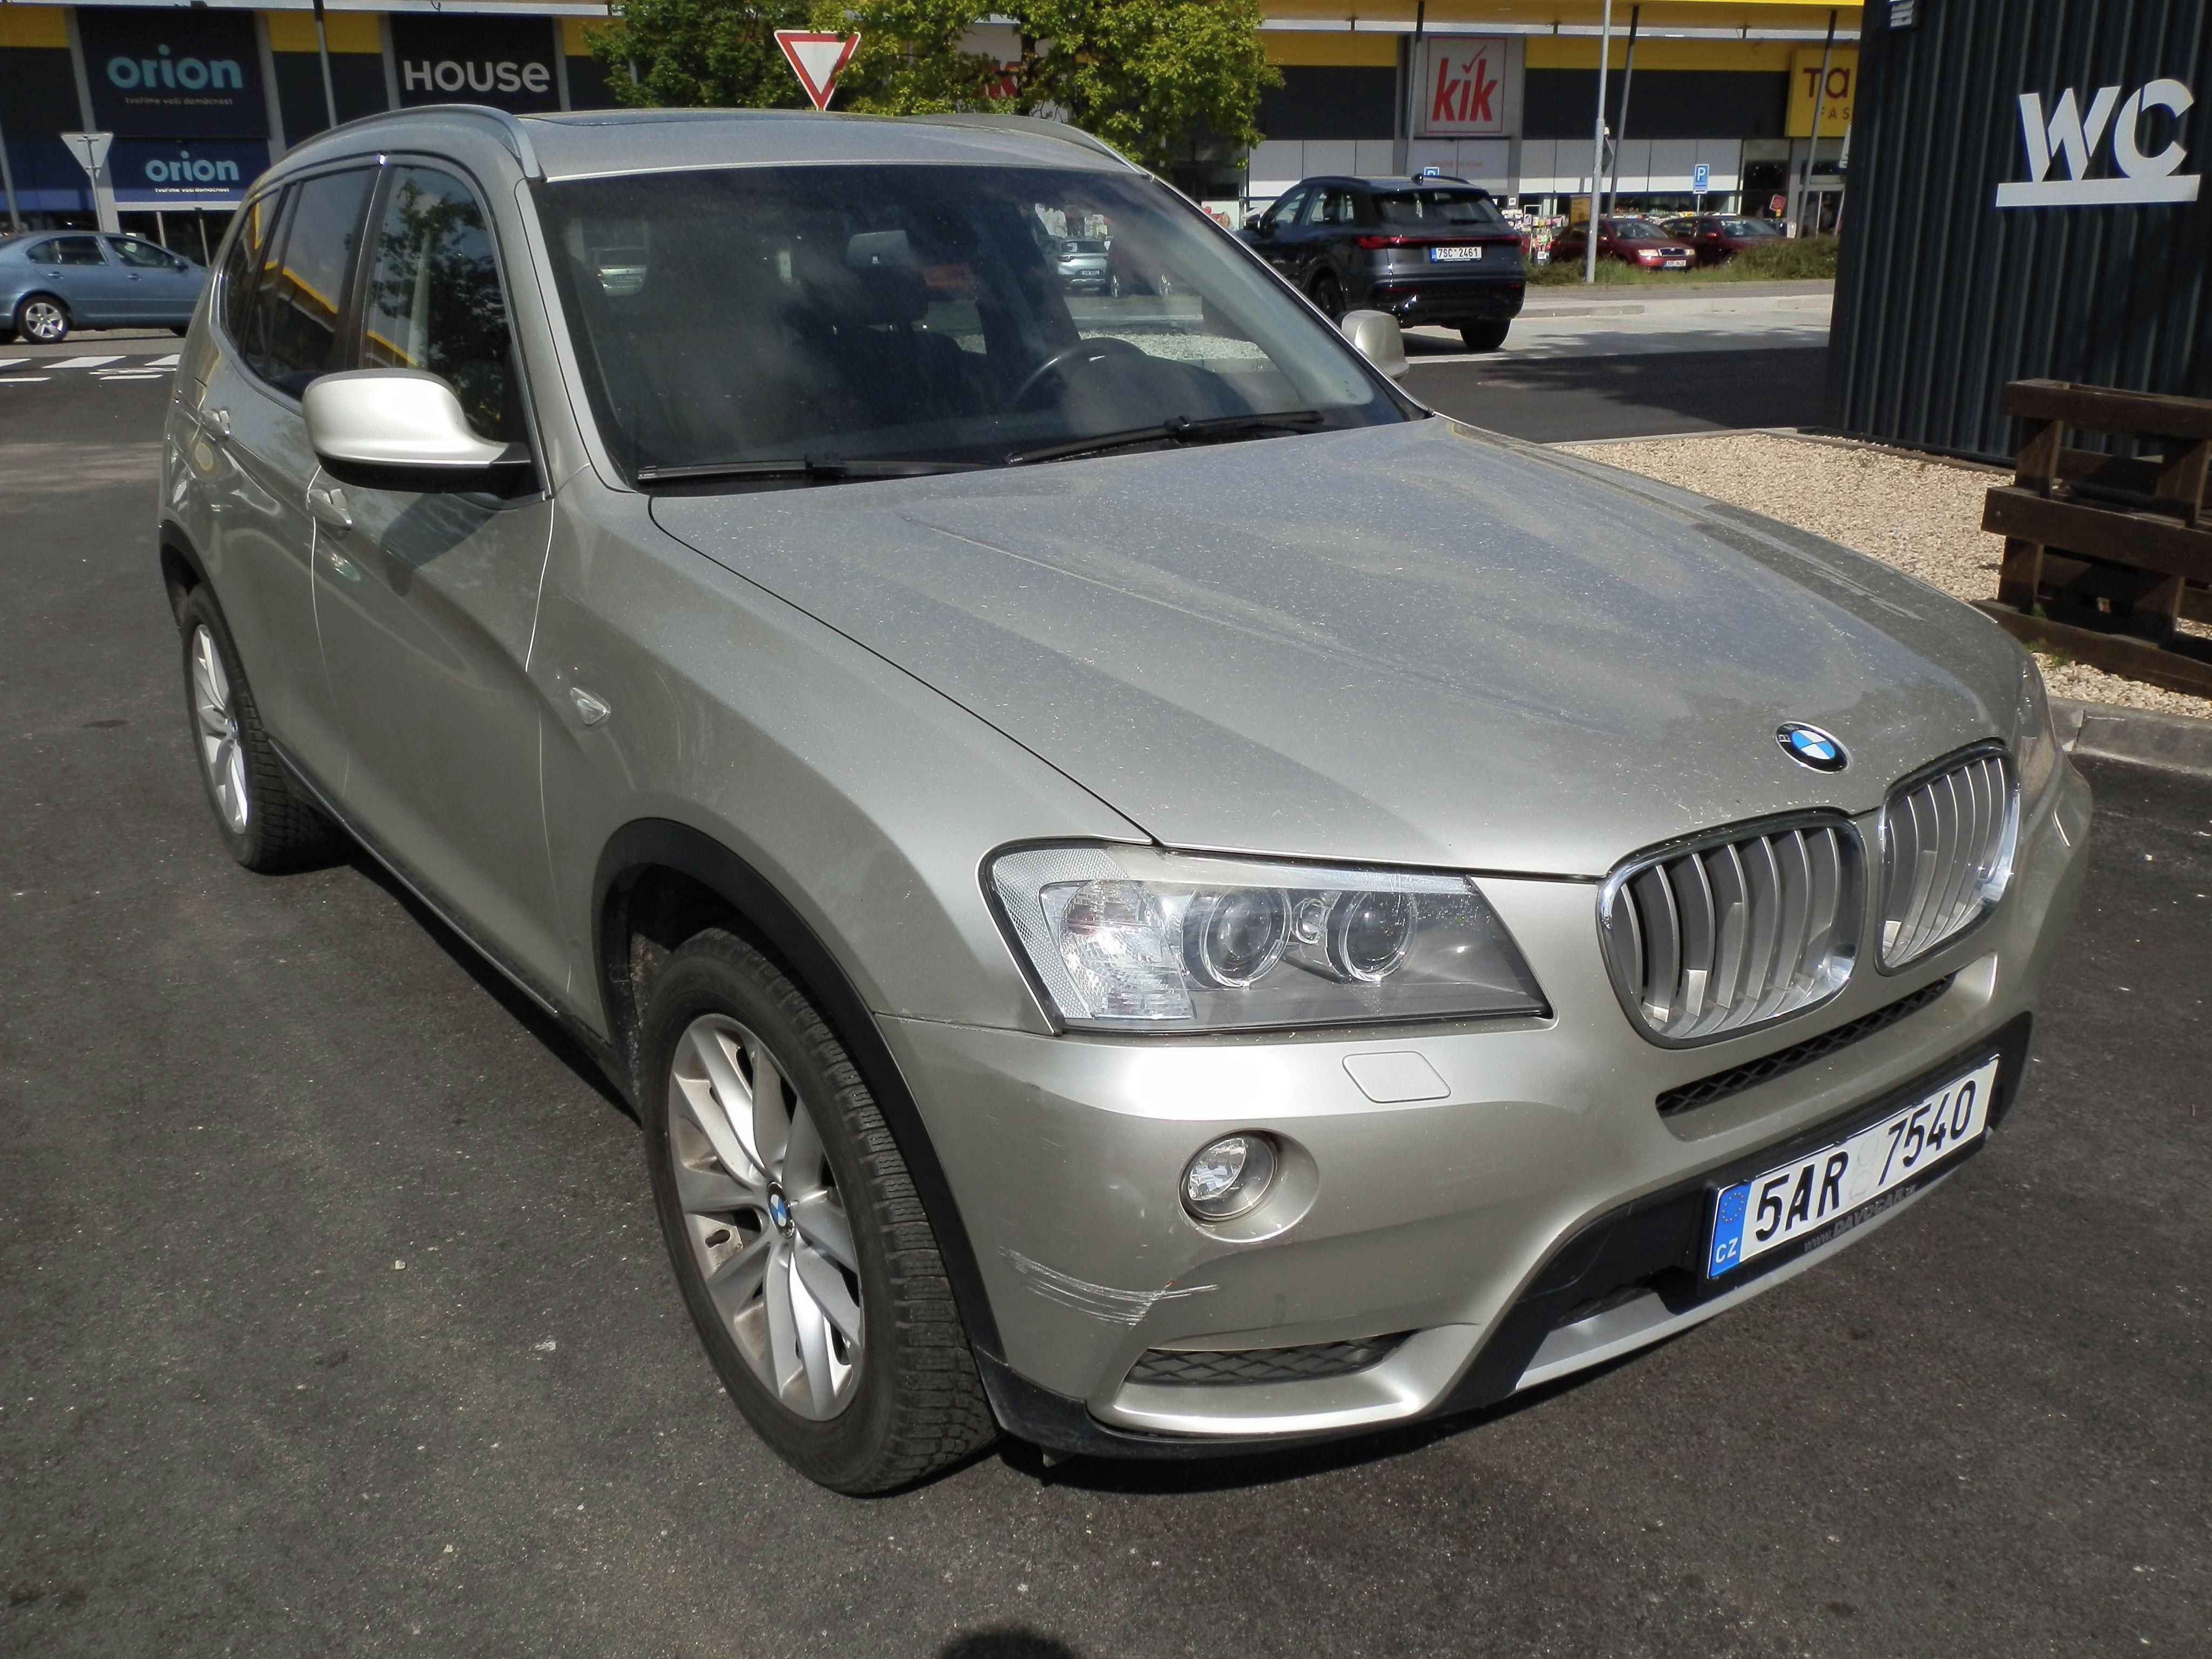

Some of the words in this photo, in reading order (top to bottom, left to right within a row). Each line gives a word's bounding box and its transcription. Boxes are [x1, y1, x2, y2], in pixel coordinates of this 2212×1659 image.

[107, 44, 242, 89] orion
[2019, 79, 2194, 183] WC
[145, 151, 239, 182] orion
[1697, 167, 1706, 181] P
[1438, 248, 1453, 258] 7SC
[1459, 248, 1478, 257] 2461
[1755, 1151, 1849, 1242] 5AR
[1878, 1080, 1976, 1186] 7540
[1715, 1237, 1738, 1264] CZ
